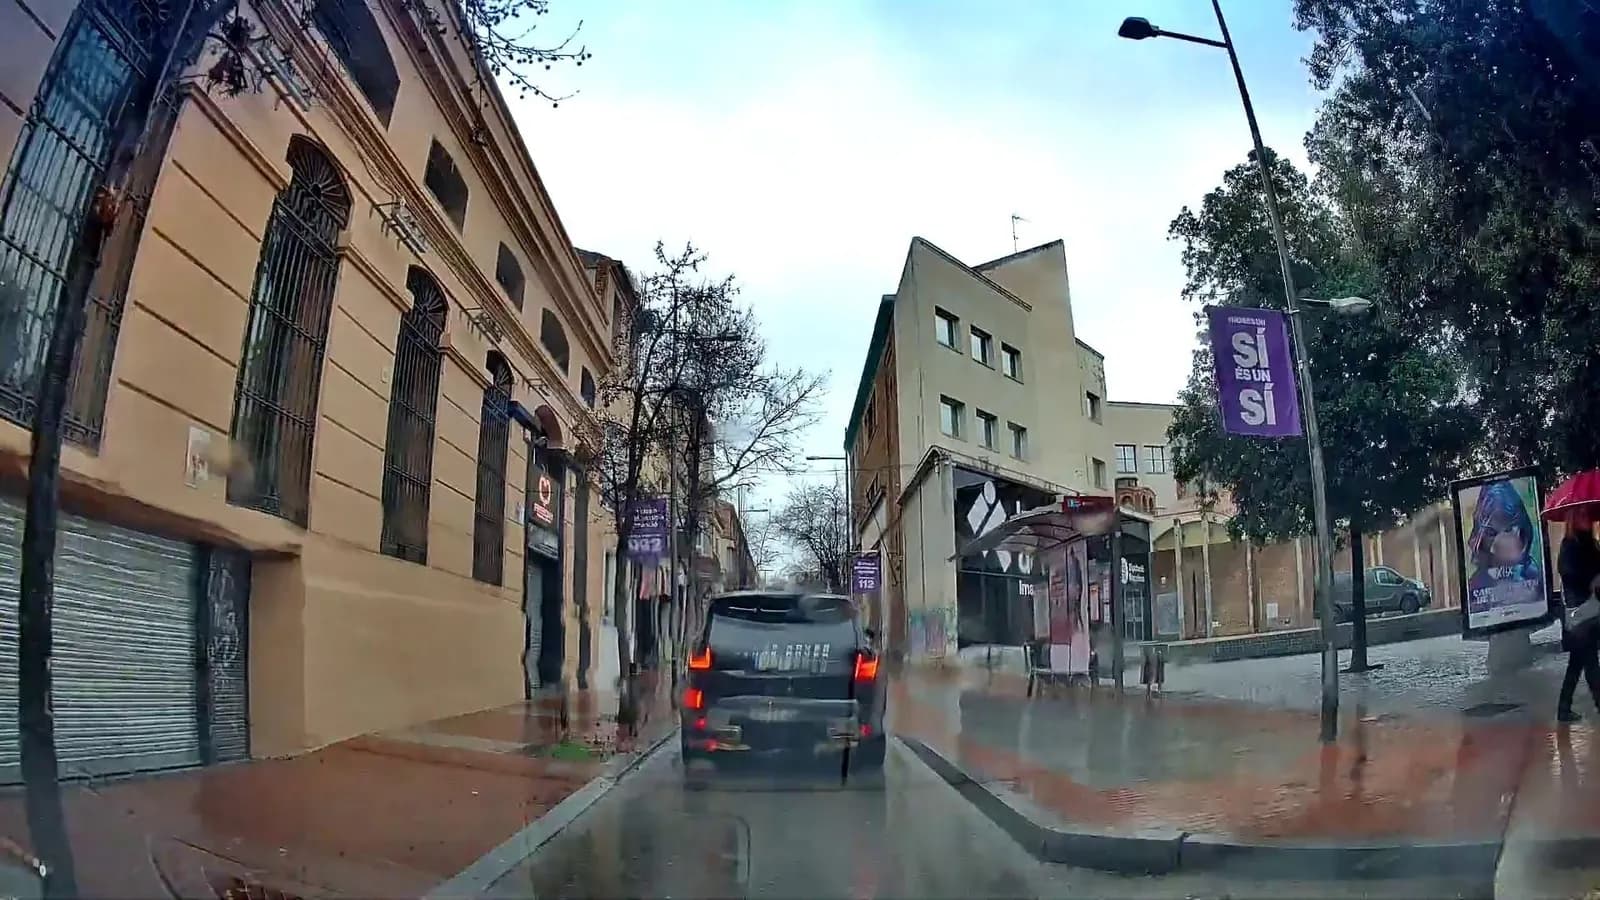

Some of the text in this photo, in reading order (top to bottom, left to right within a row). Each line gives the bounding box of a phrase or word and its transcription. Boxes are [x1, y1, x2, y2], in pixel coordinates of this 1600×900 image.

[1231, 327, 1269, 368] SÍ
[1252, 369, 1271, 382] UN
[1239, 382, 1277, 426] SÍ
[858, 579, 875, 589] 112
